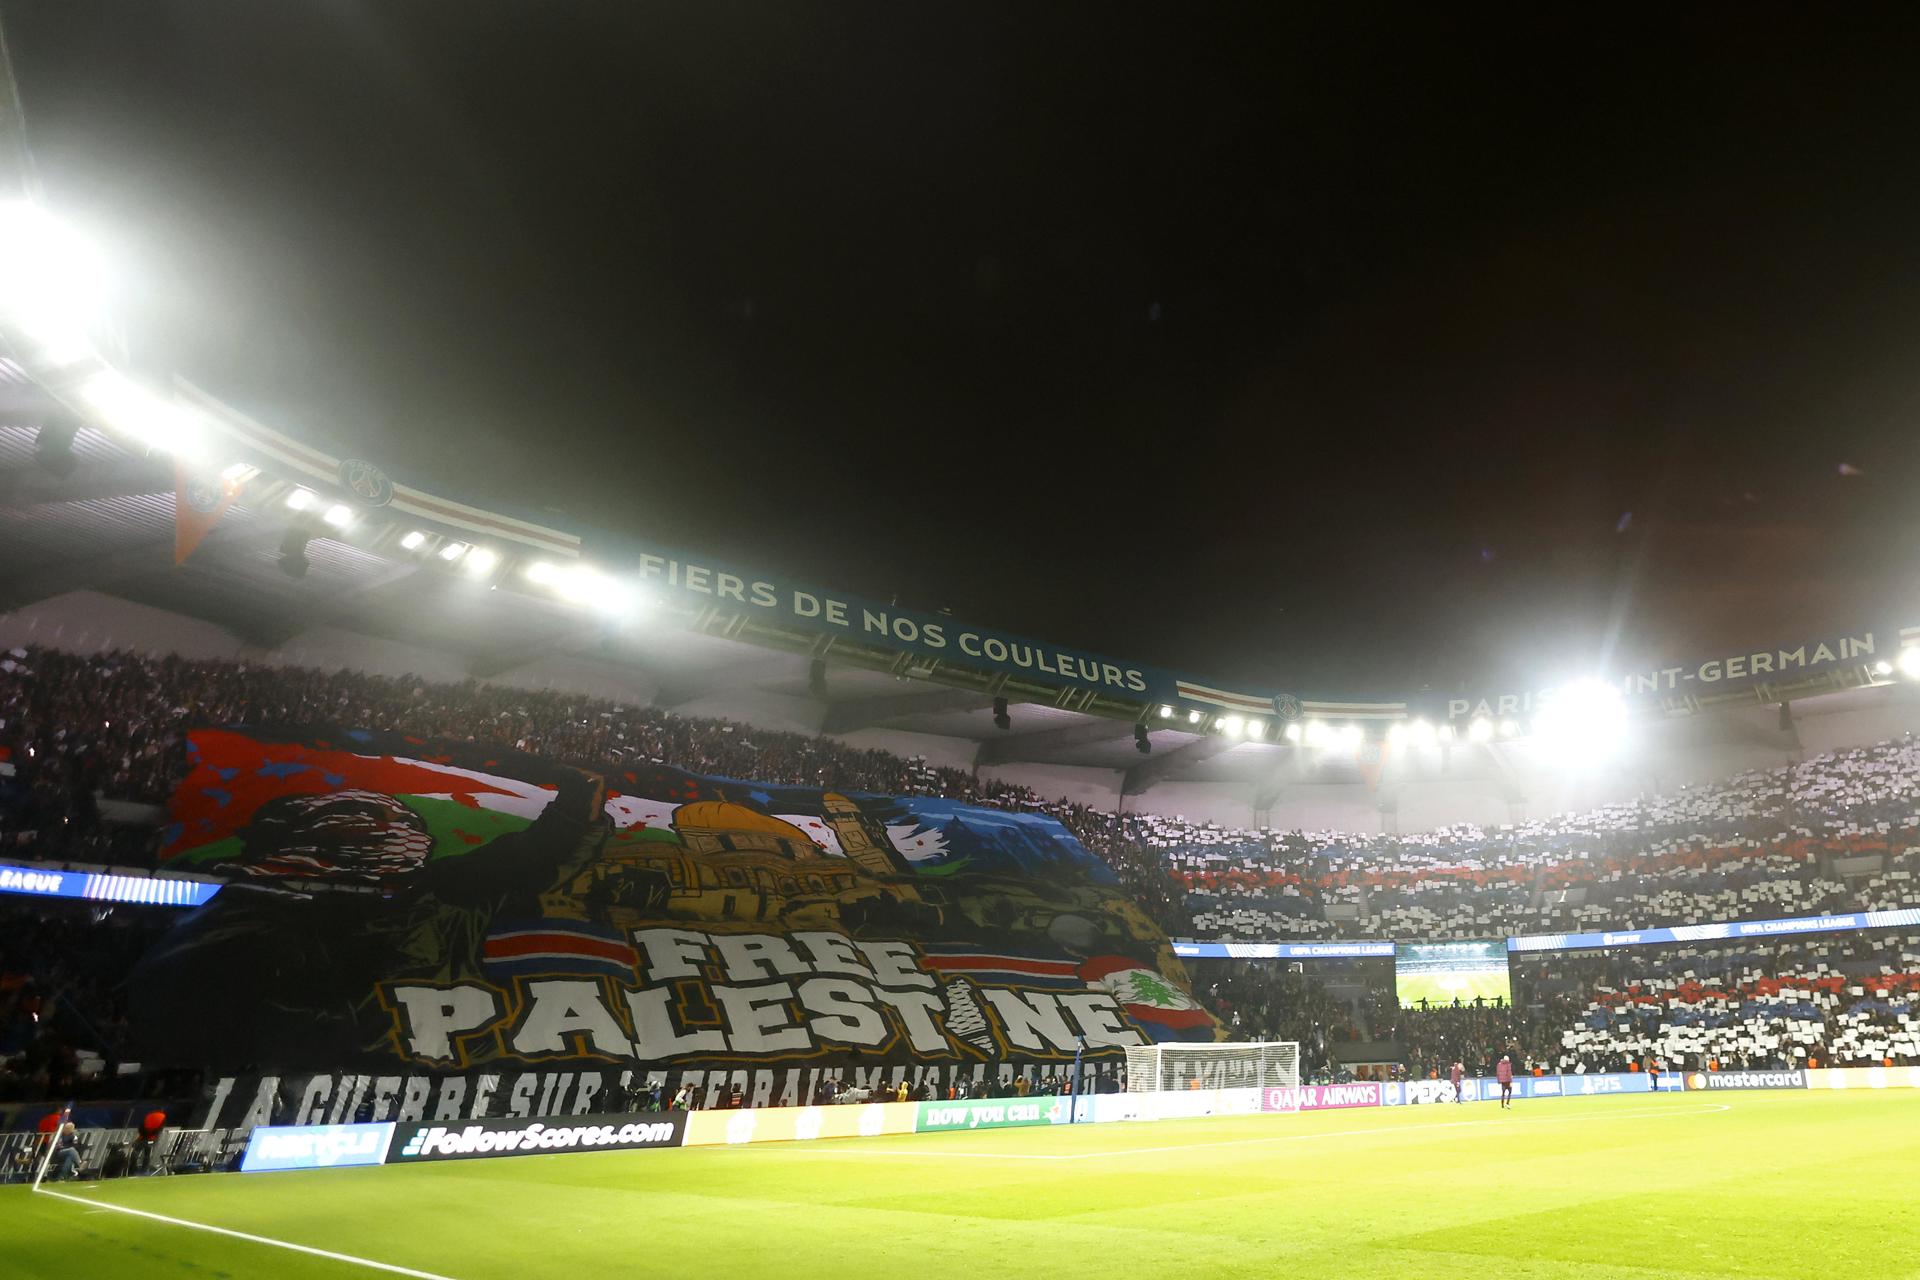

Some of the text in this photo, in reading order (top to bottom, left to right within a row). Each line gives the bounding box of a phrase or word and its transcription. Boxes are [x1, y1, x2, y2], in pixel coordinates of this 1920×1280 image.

[640, 553, 1147, 691] FIERS DE NOS COULEURS
[1624, 632, 1875, 696] INT-GERMAIN
[0, 869, 64, 892] EAGUE
[632, 928, 936, 989] FREE
[391, 978, 1145, 1062] PALESTINE
[505, 1072, 602, 1119] SUR
[1322, 1085, 1377, 1106] AIRWAYS
[1405, 1079, 1457, 1105] PEPS
[1709, 1070, 1803, 1088] mastercard
[926, 1104, 1039, 1129] now you can
[419, 1122, 672, 1156] FollowScores.com
